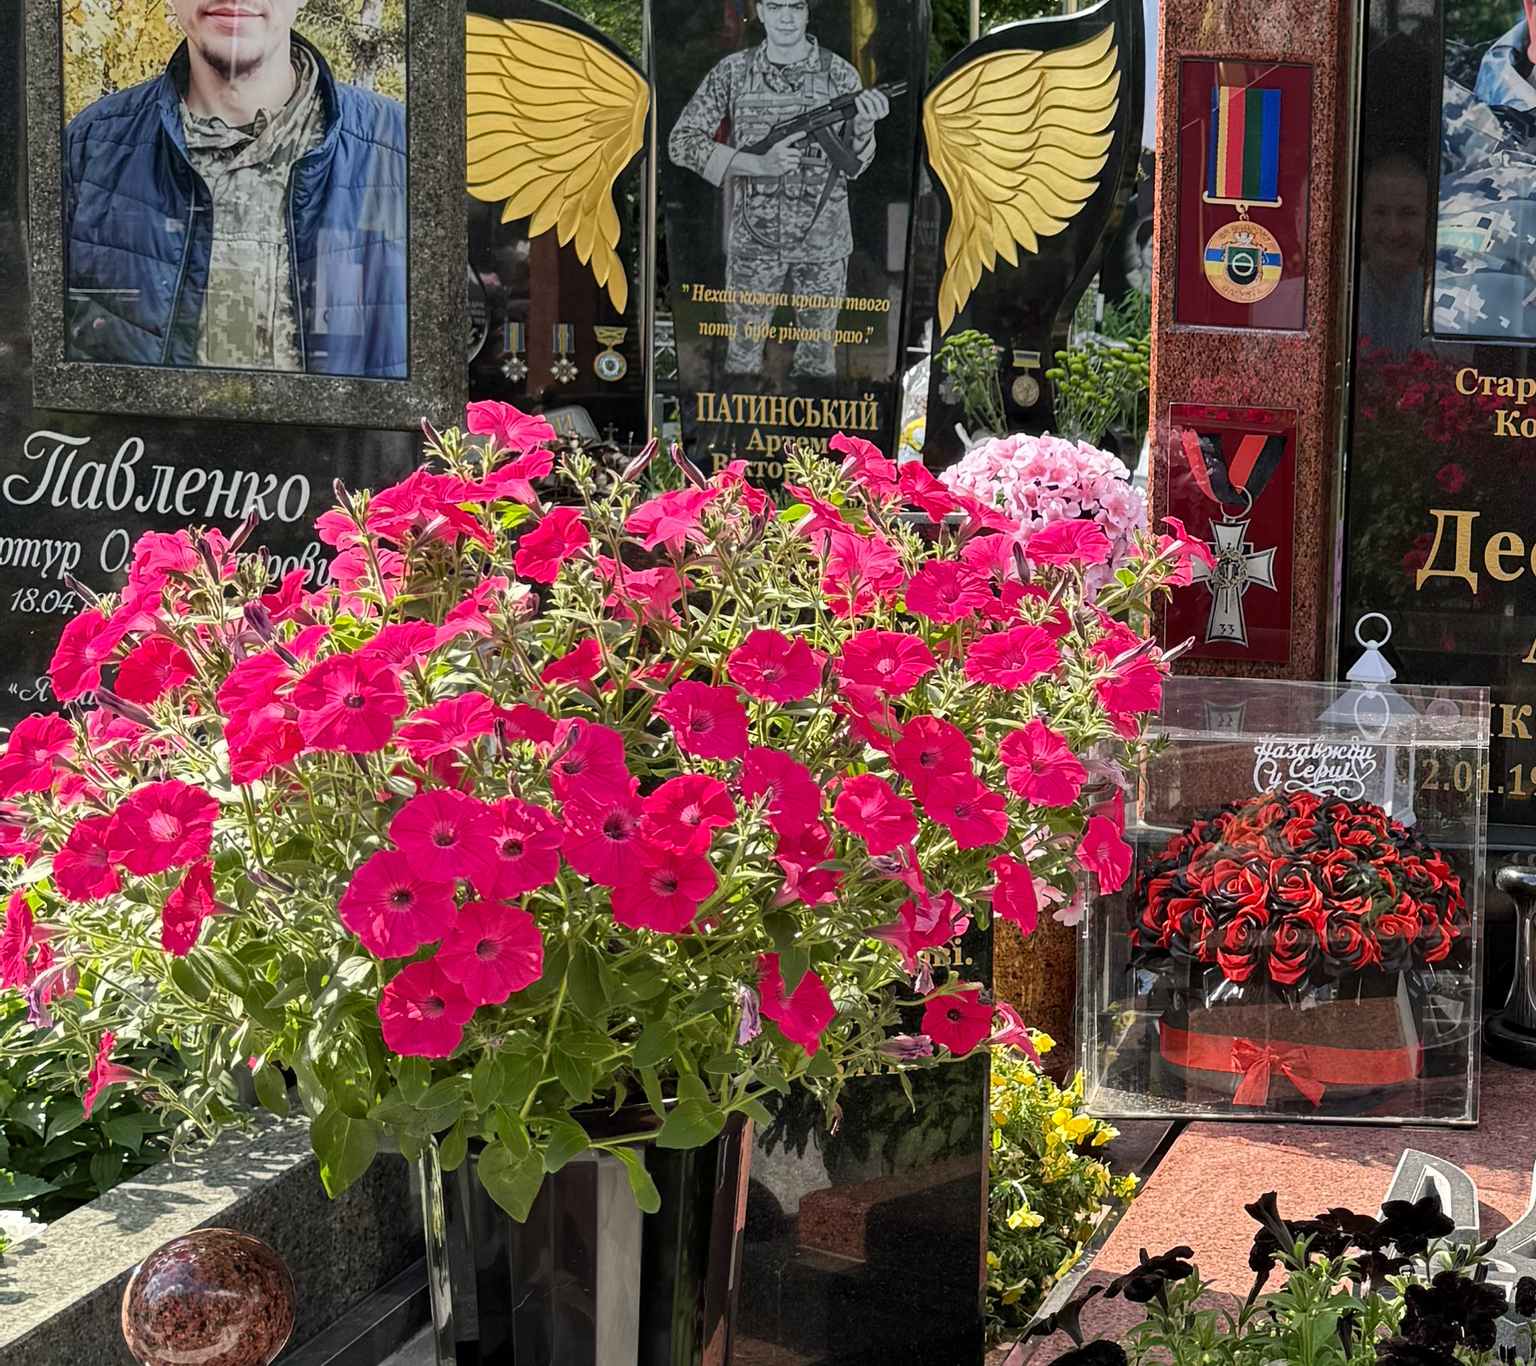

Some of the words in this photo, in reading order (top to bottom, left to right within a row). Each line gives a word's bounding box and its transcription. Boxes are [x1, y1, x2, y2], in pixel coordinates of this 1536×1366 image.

[739, 291, 789, 308] кожна
[845, 298, 890, 313] твого
[744, 322, 776, 343] буде
[696, 392, 878, 431] ПАТИНСЬКИЙ
[746, 428, 829, 458] Артем
[2, 430, 311, 523] Павленко
